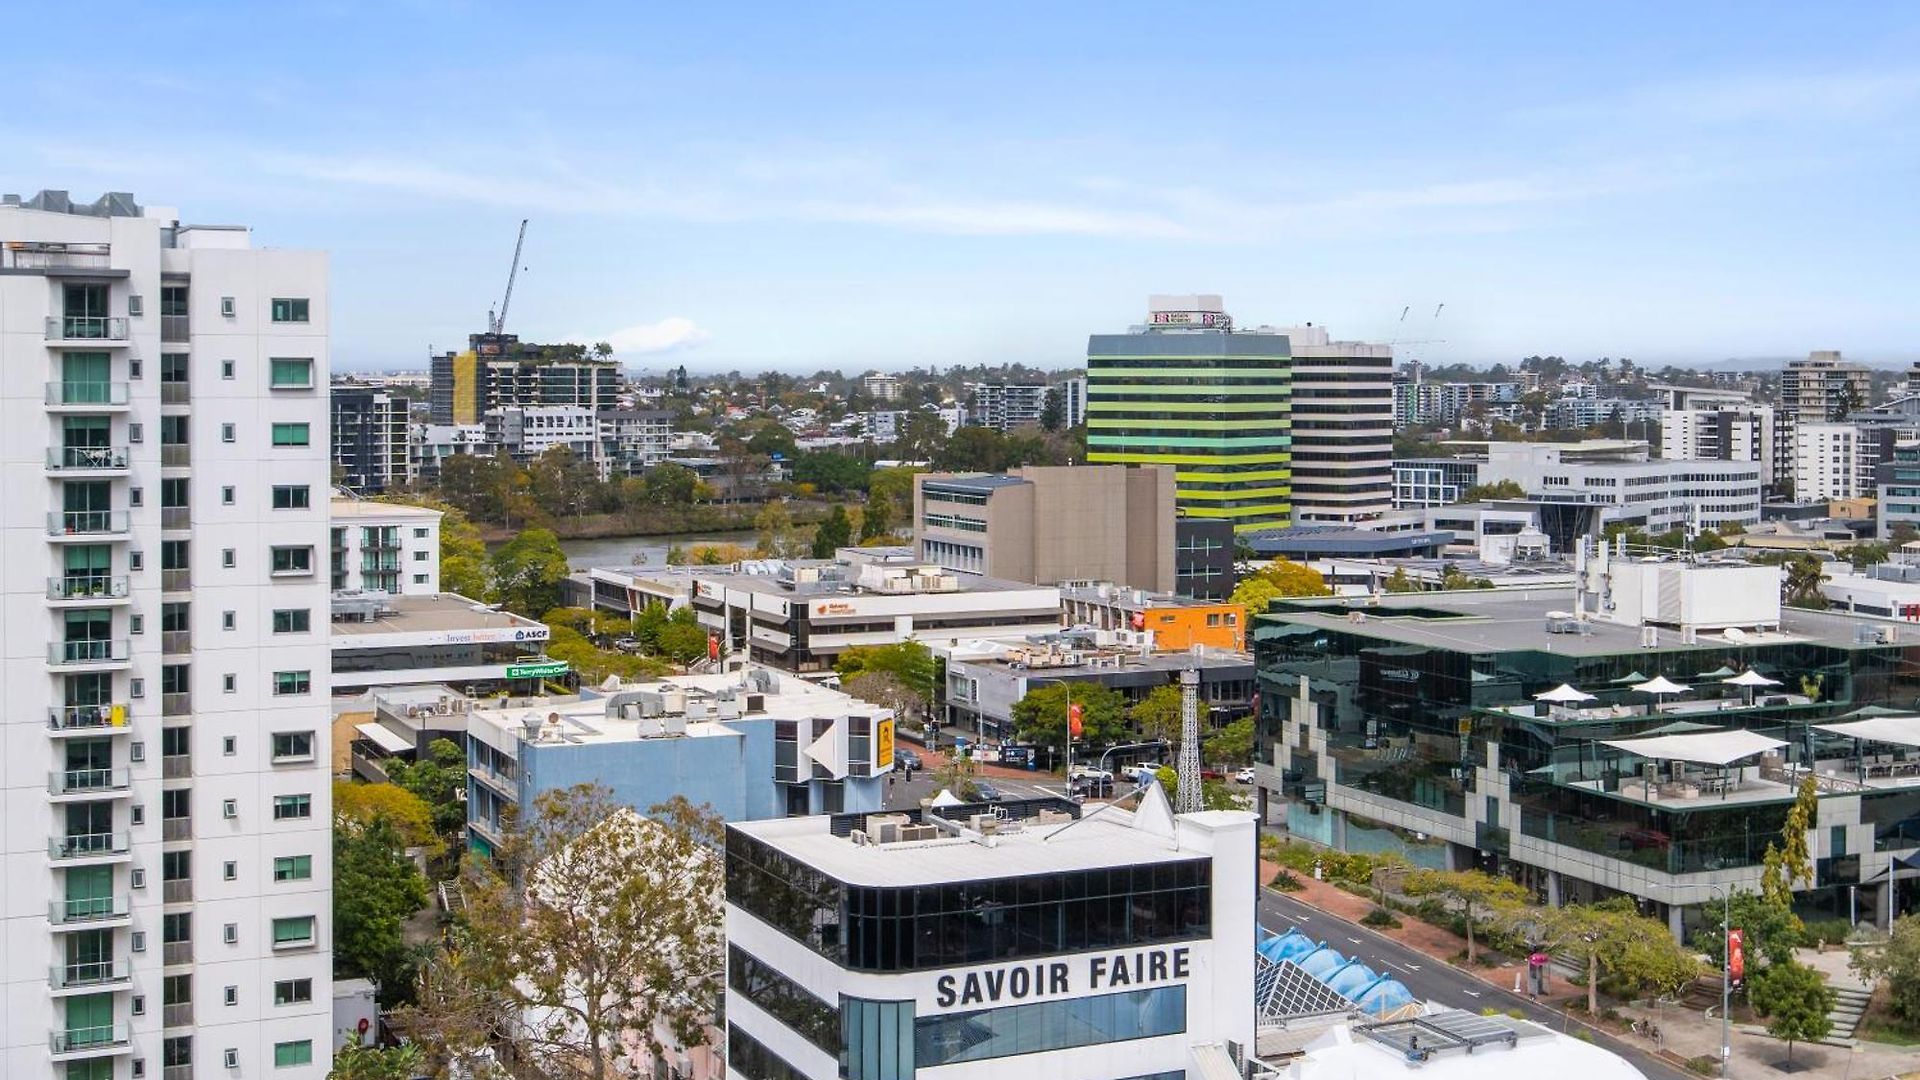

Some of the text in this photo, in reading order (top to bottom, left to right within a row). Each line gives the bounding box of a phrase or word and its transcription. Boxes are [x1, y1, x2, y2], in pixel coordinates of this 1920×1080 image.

[525, 630, 547, 638] ASCF
[936, 948, 1190, 1007] SAVOIR FAIRE
